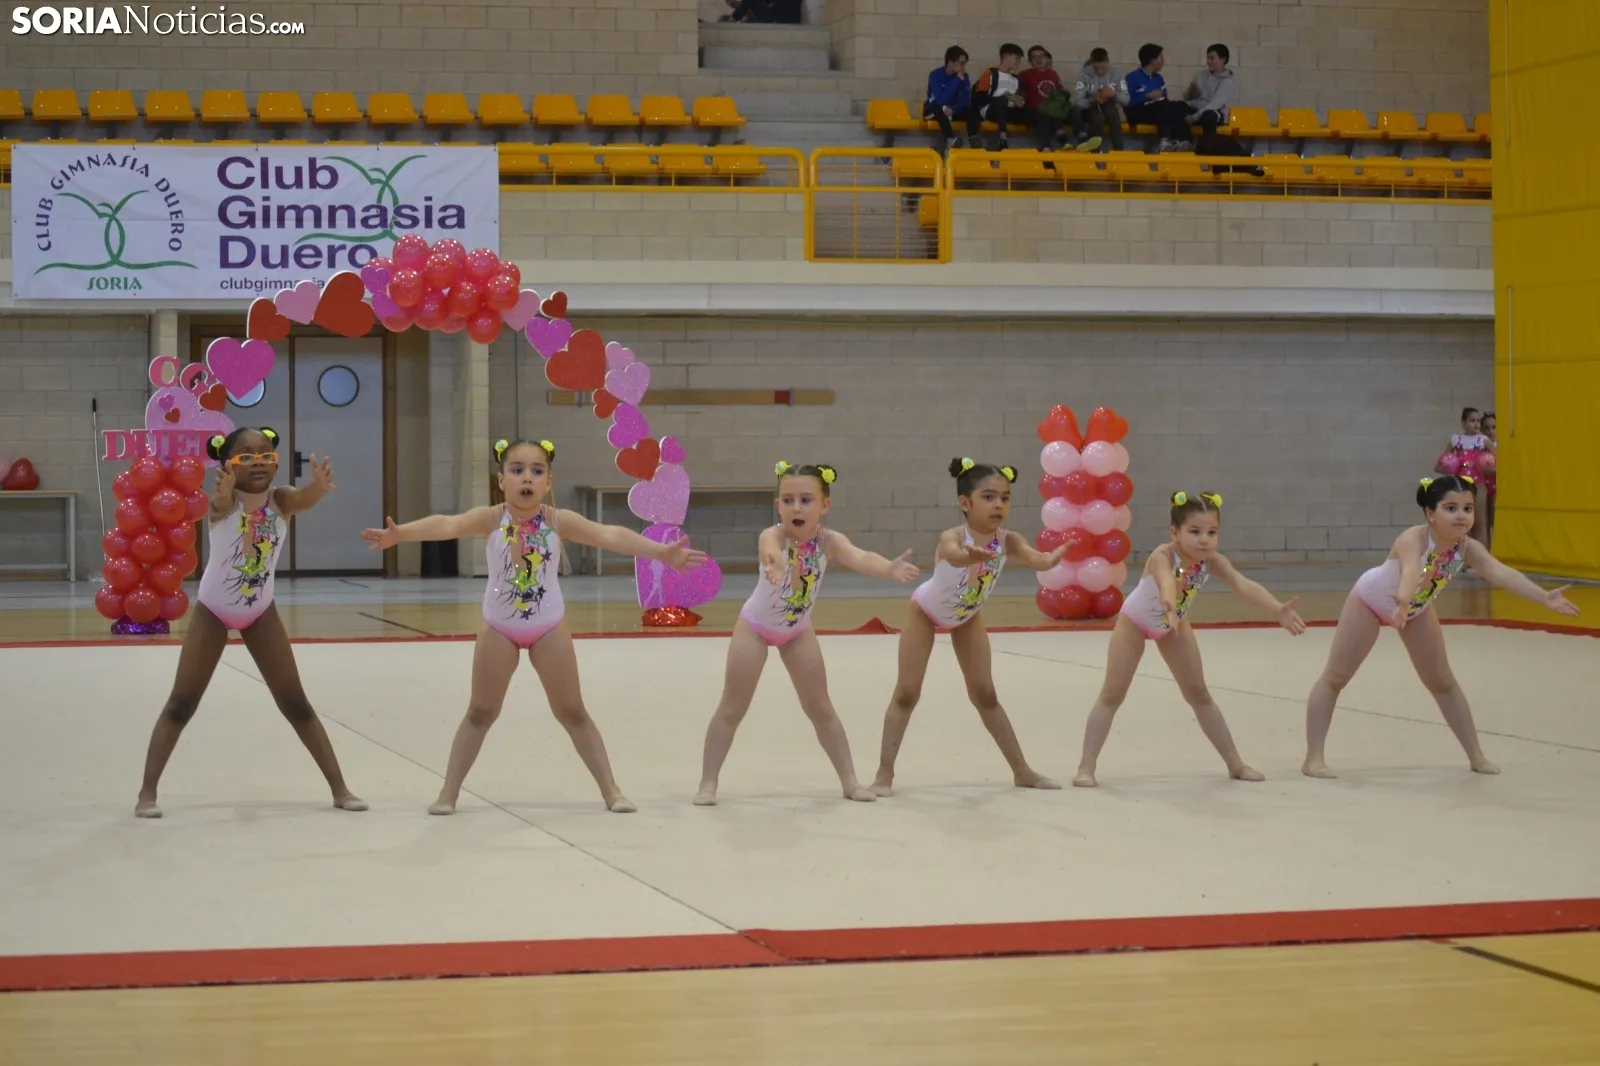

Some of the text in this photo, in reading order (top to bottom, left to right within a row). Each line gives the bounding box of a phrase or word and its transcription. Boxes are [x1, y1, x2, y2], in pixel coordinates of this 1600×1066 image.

[217, 156, 339, 190] Club
[35, 152, 185, 252] CLUB GIMNASIA DUERO
[217, 195, 466, 229] Gimnasia
[219, 235, 379, 269] Duero
[87, 276, 143, 291] SORIA
[219, 277, 325, 292] clubgimna
